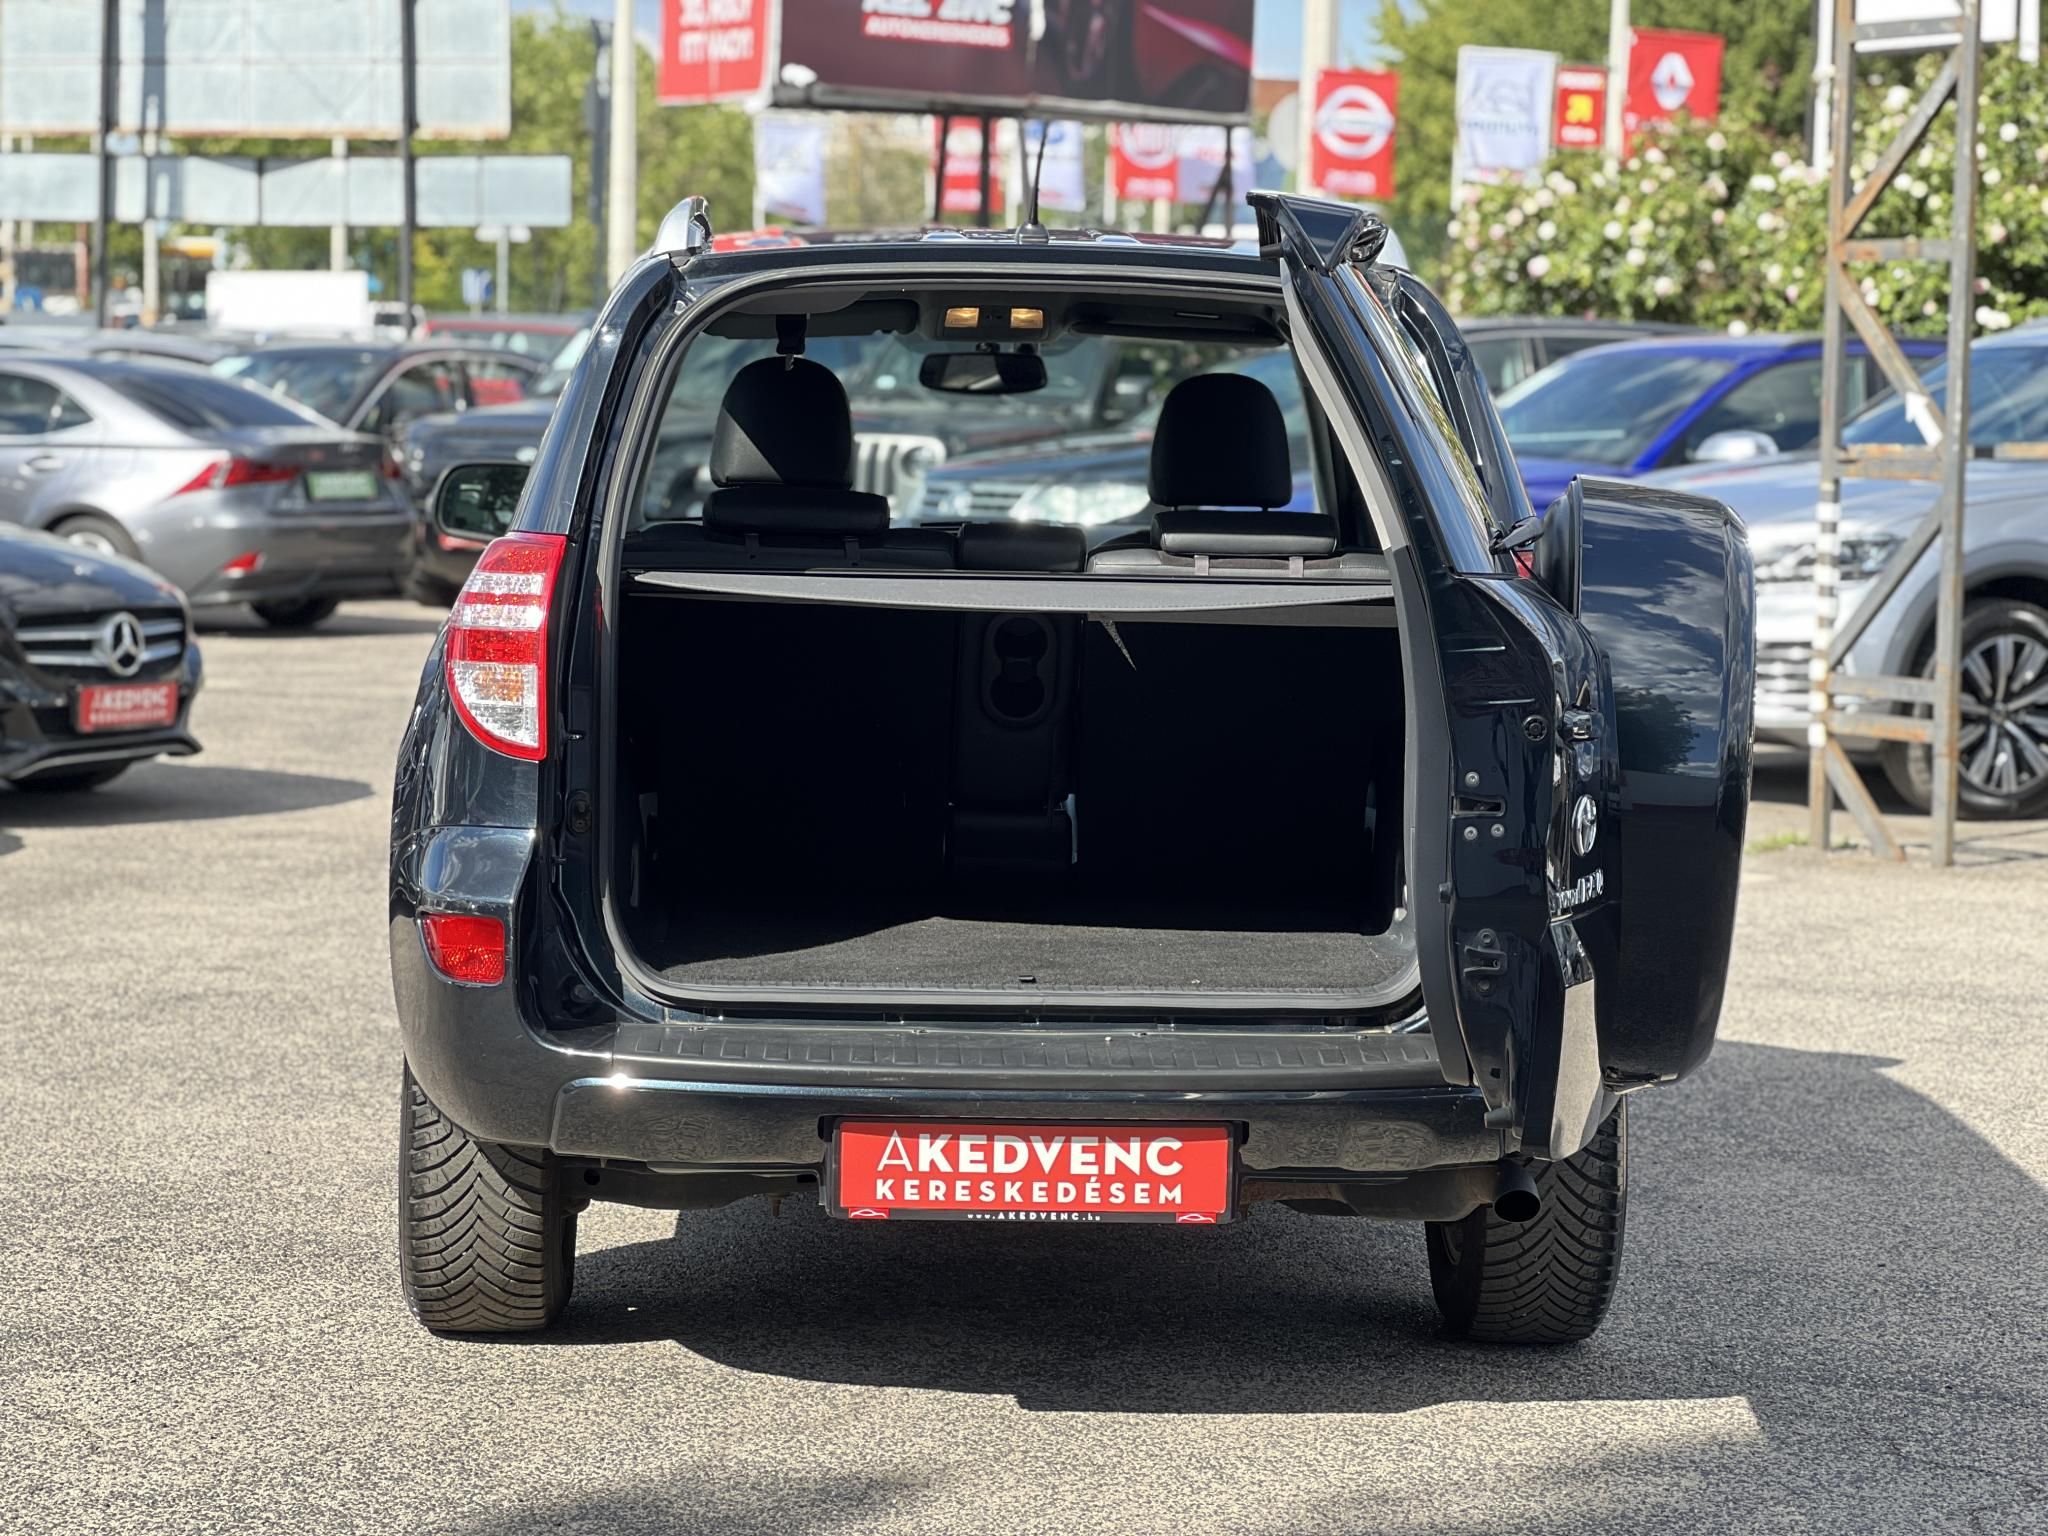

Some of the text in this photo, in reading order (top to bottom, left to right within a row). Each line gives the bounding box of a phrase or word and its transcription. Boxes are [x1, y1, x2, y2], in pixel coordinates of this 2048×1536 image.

[876, 1129, 1184, 1176] AKEDVENC
[875, 1176, 1183, 1205] KERESKEDÉSEM
[967, 1211, 1101, 1221] www.AKEDVENC.hu
